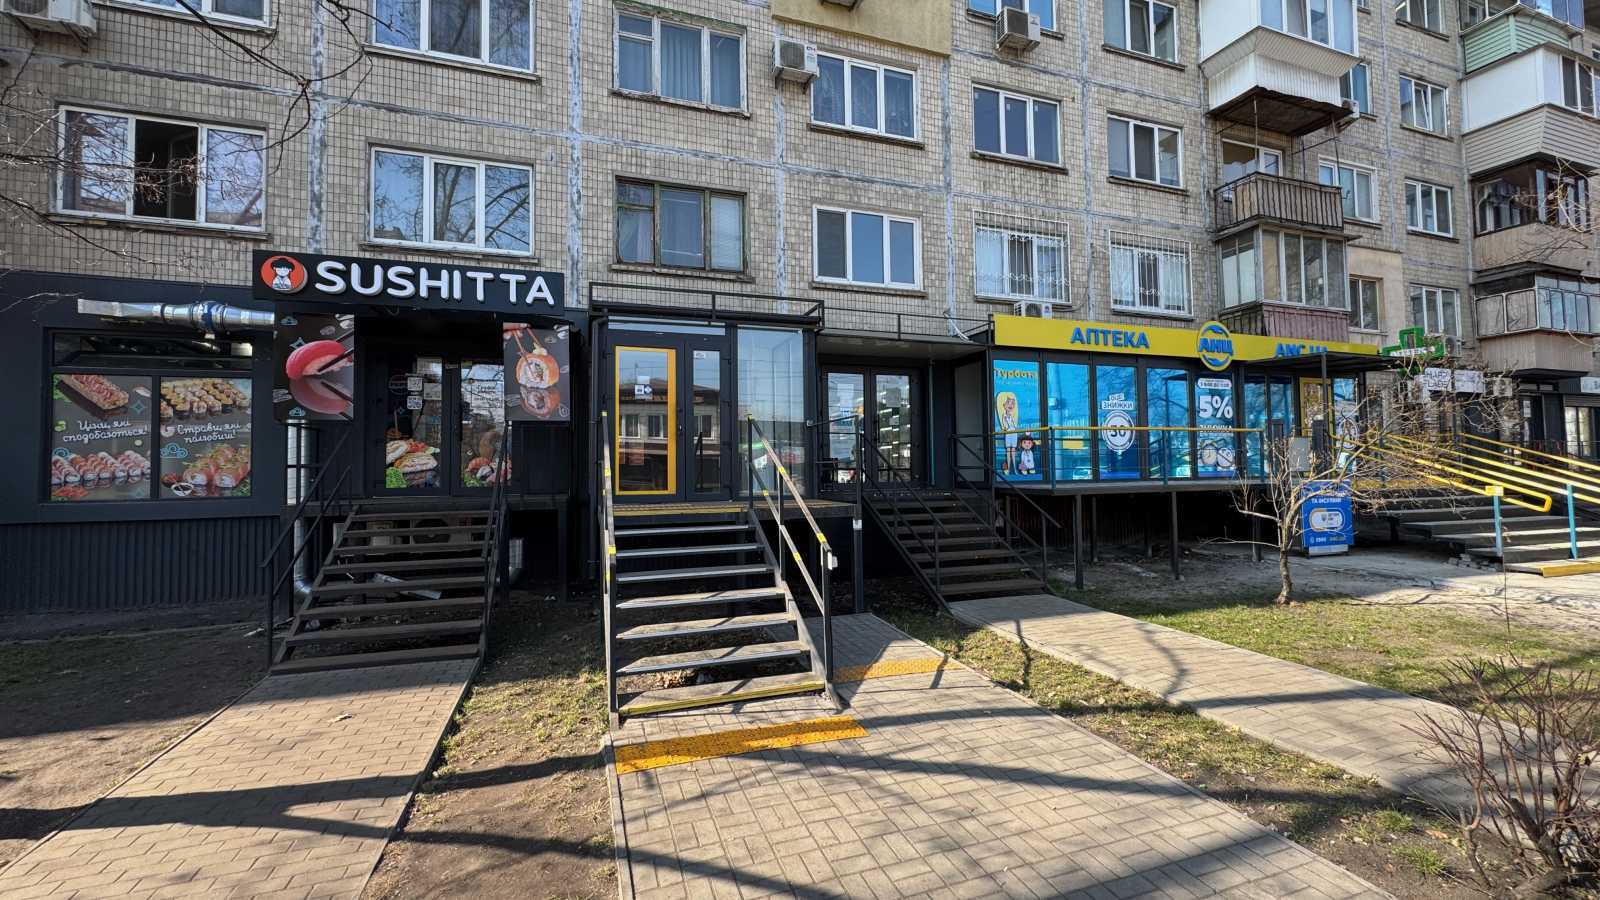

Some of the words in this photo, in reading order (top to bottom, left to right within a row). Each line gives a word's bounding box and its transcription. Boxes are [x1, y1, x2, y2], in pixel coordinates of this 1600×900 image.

[315, 260, 555, 306] SUSHITTA
[1070, 327, 1150, 349] АПТЕКА
[1103, 401, 1133, 409] ЗНИЖКИ
[1199, 395, 1234, 419] 5%
